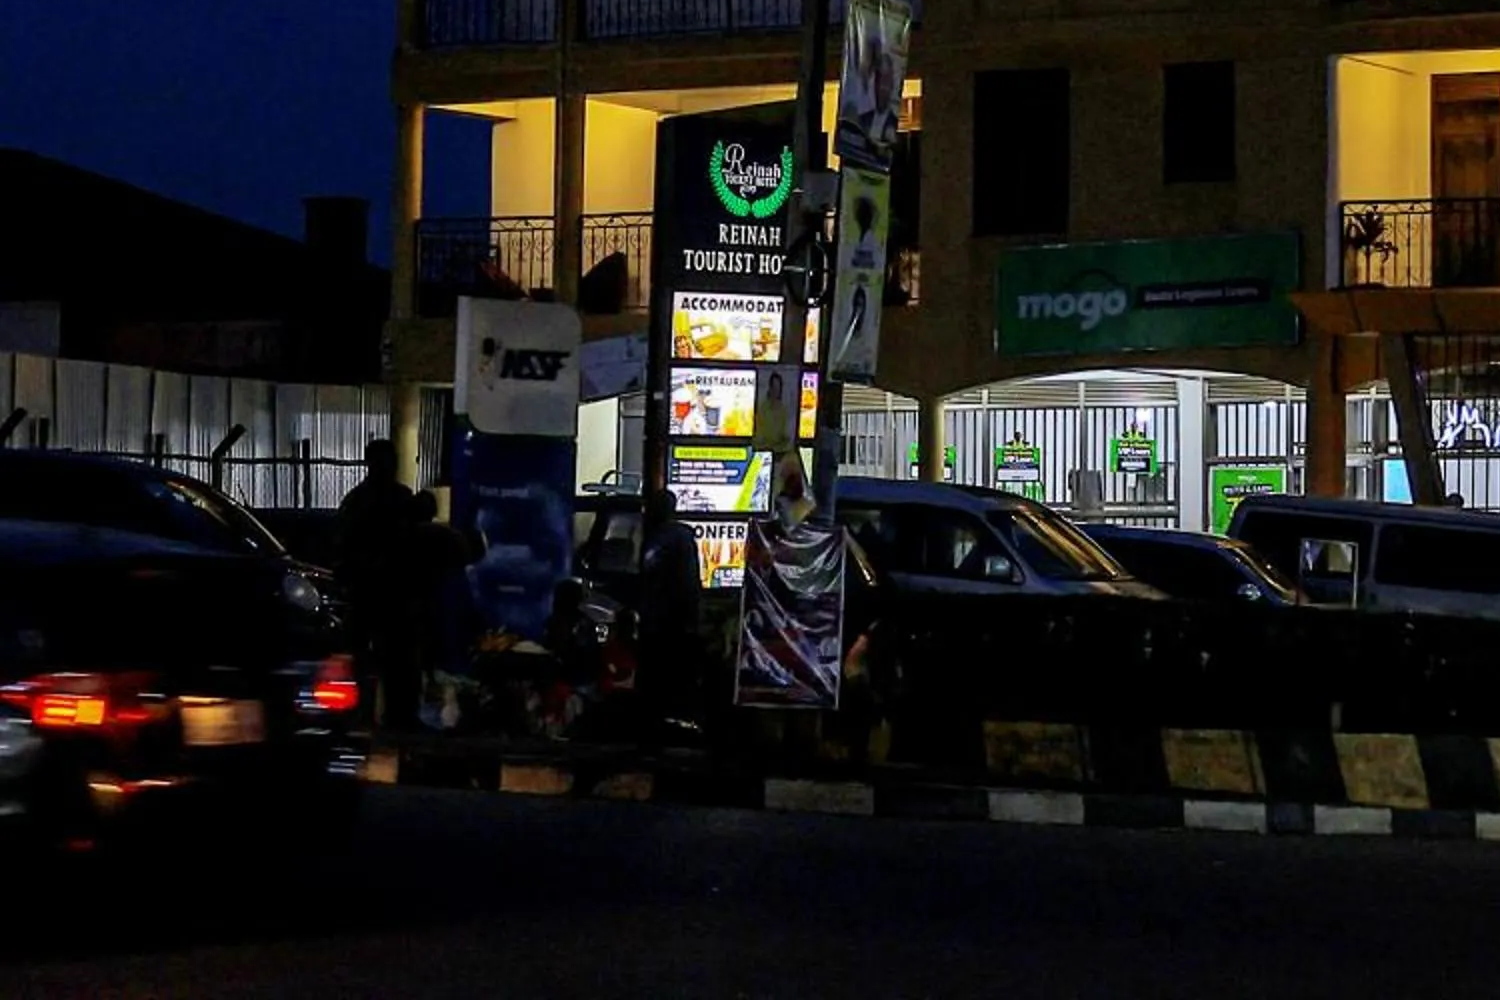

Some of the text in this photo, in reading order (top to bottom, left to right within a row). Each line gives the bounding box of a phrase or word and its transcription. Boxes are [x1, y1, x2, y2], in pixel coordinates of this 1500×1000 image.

[722, 143, 781, 179] Reinah
[719, 224, 781, 247] REINAH
[683, 250, 787, 275] TOURIST HO
[680, 297, 785, 314] ACCOMMODAT
[1016, 288, 1128, 331] mogo
[500, 349, 570, 381] NSSF
[695, 375, 754, 387] RESTAURAN
[694, 525, 745, 539] ONFER
